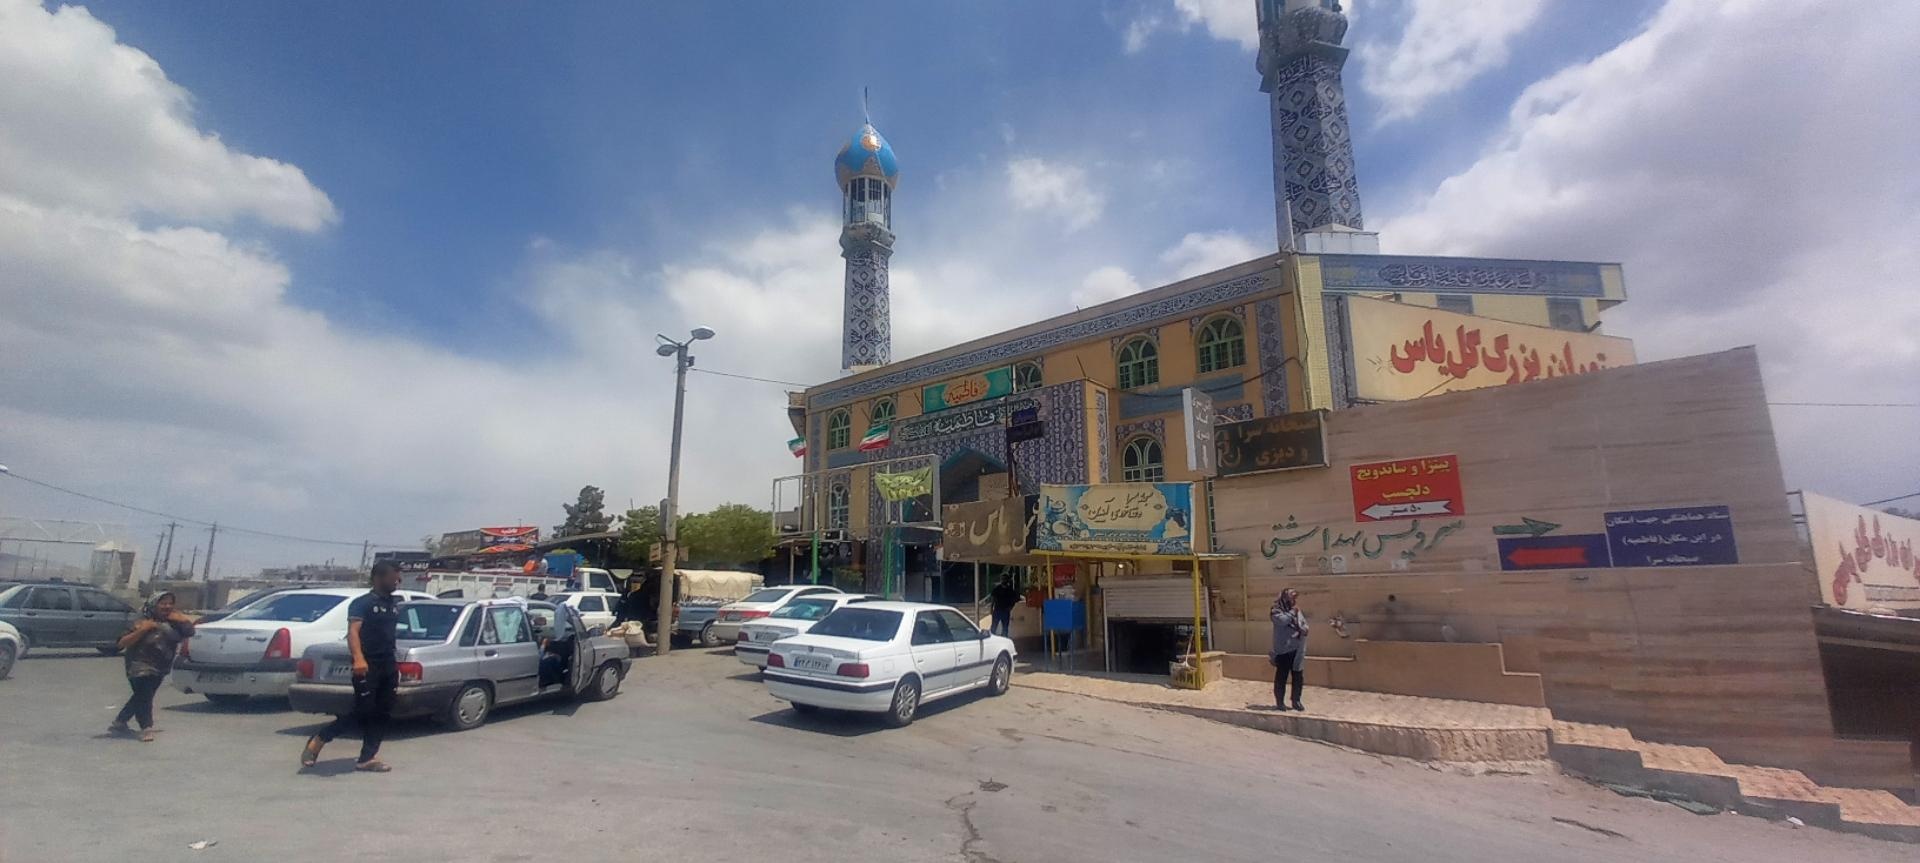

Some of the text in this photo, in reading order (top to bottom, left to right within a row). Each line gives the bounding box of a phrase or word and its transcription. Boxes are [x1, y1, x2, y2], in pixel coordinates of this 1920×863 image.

[1446, 325, 1481, 379] گل
[1356, 459, 1450, 481] پیتزا و ساندویچ
[1260, 514, 1465, 560] سرویس بهداشتی
